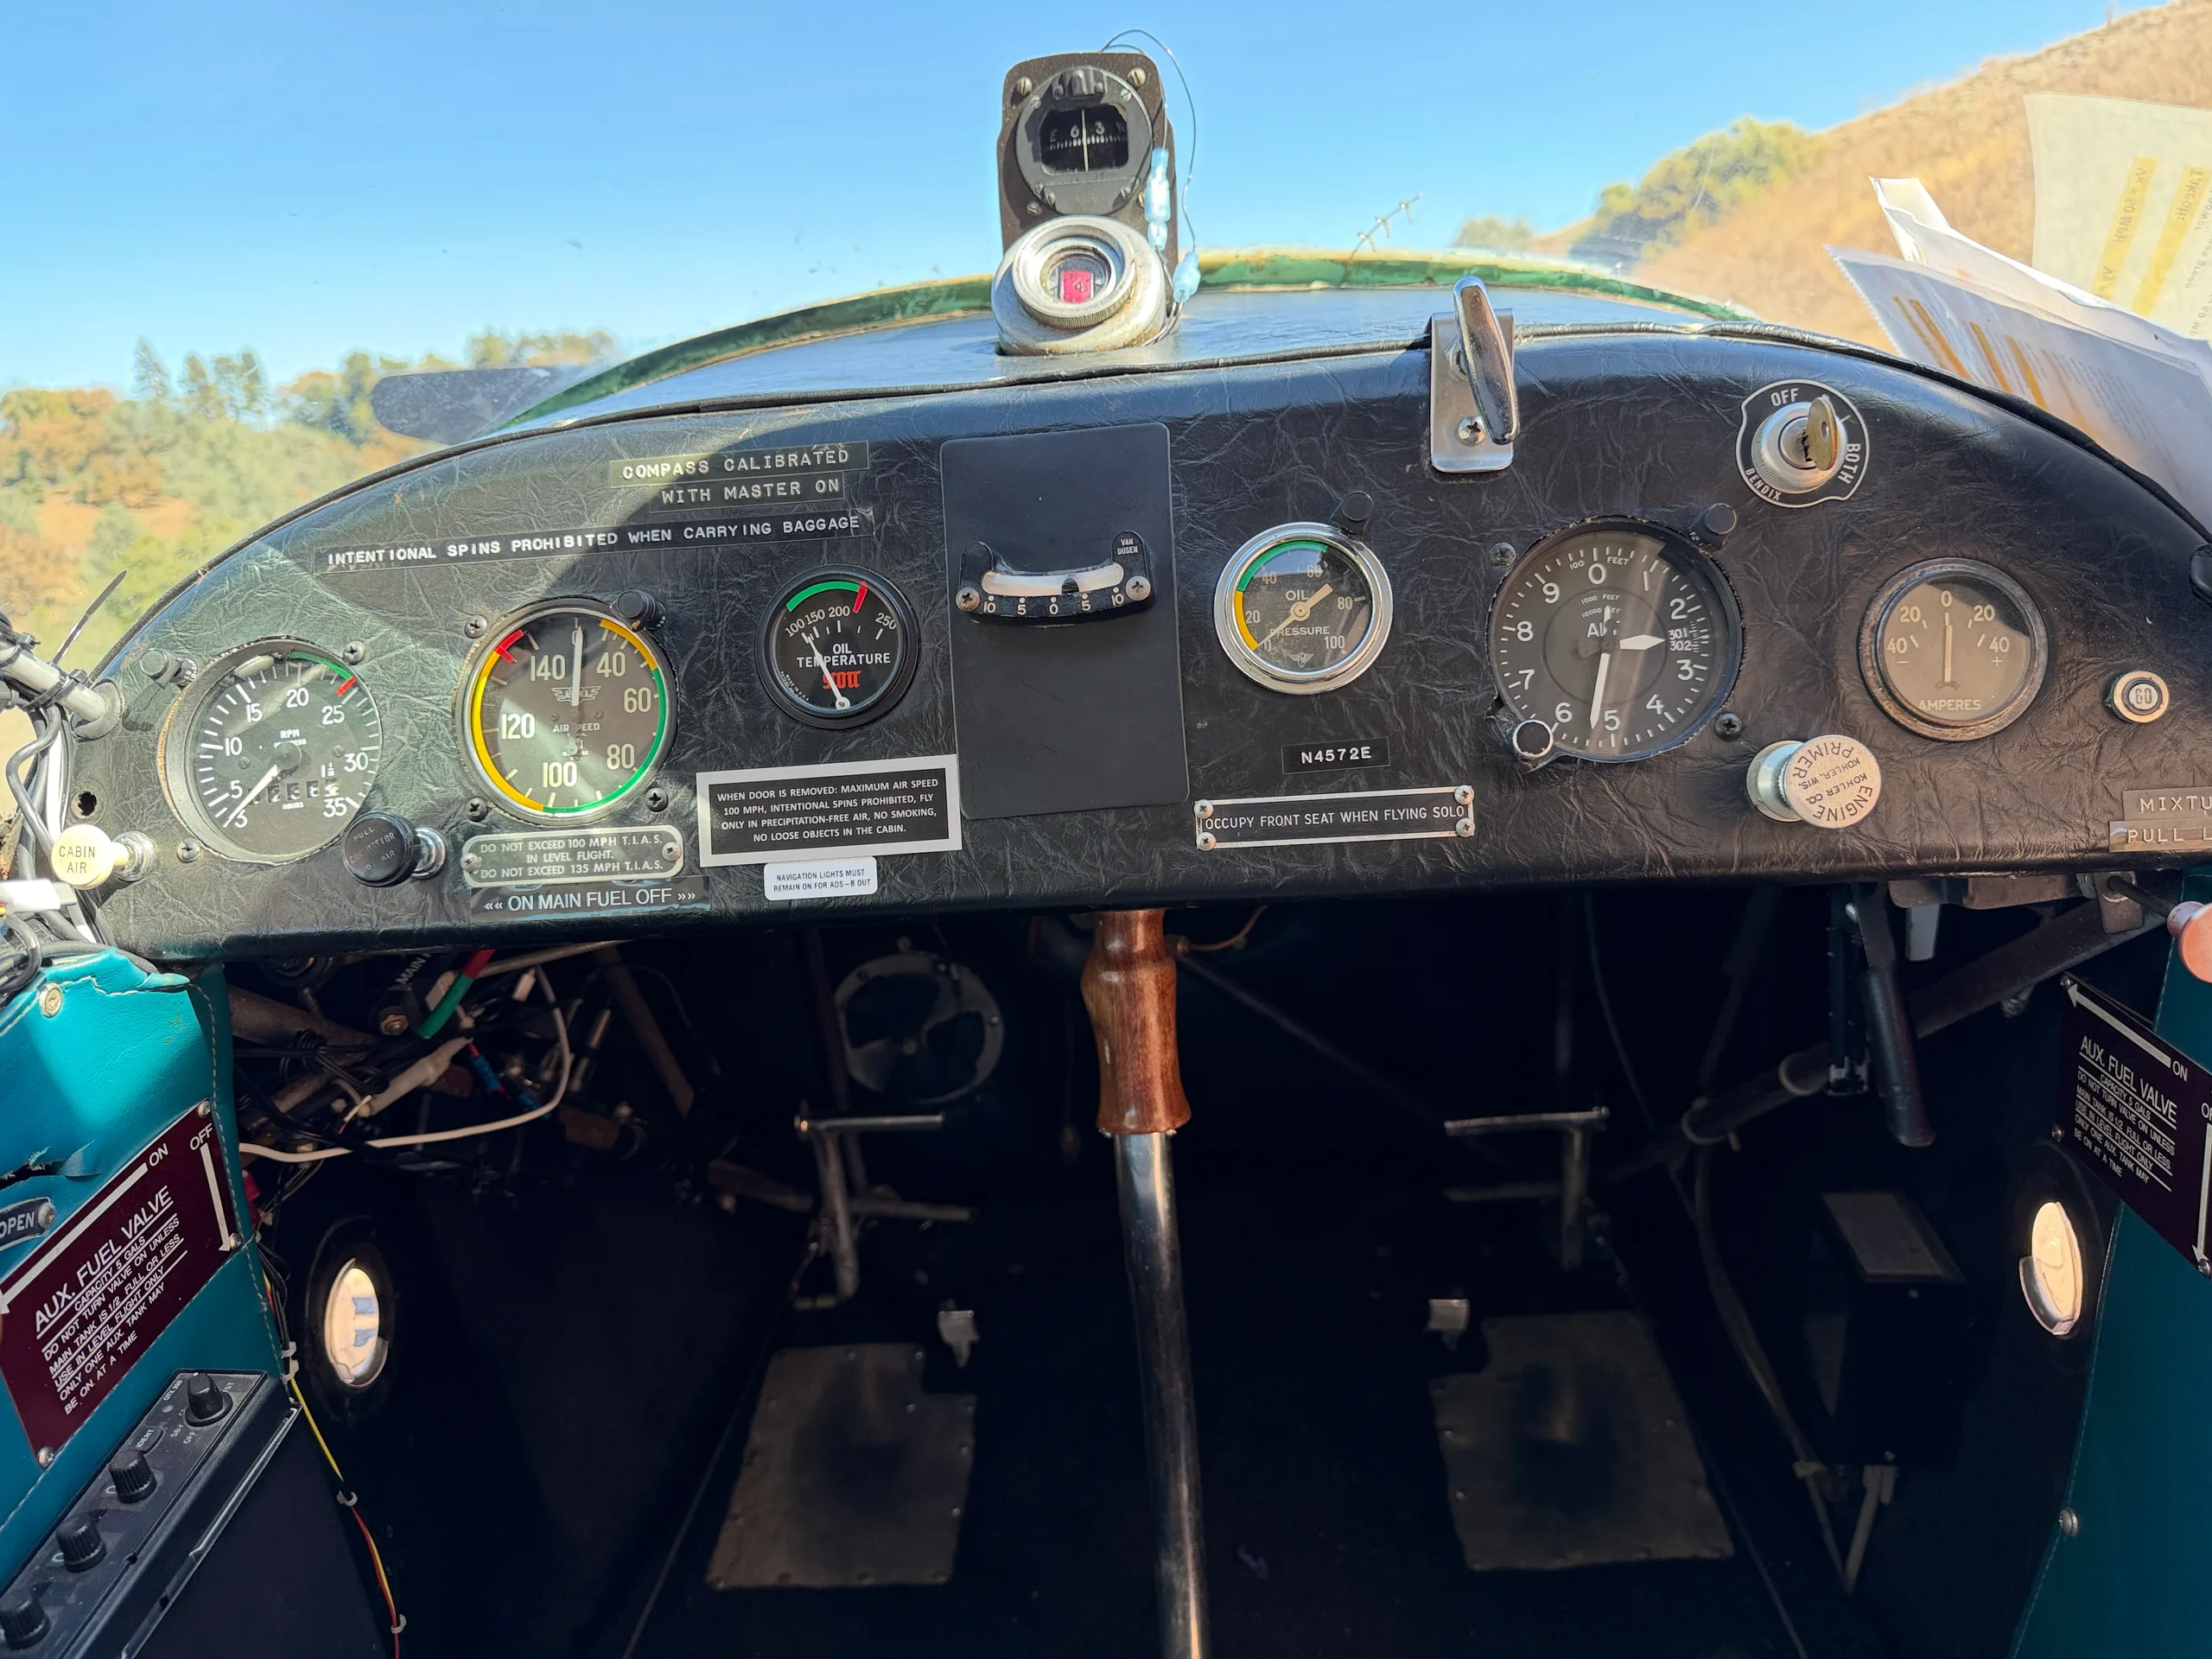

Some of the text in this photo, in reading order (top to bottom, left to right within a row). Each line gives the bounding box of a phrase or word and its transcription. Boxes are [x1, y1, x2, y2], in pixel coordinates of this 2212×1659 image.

[1070, 121, 1105, 137] 6 3
[1770, 388, 1799, 406] OFF
[622, 448, 849, 480] COMPASS CALIBRATED
[1837, 443, 1861, 484] BOTH
[661, 478, 840, 505] WITH MASTER ON
[1745, 467, 1782, 501] BENDIX
[327, 514, 860, 566] INTENTIONAL SPINS PROHIBITED WHEN CARRYING BAGGAGE
[1117, 545, 1138, 555] DUSEN
[1120, 537, 1134, 546] VAN
[1569, 556, 1630, 570] 100 FEET
[1588, 563, 1607, 585] 0
[982, 594, 1124, 615] 10 5 0 5 10
[1285, 590, 1309, 601] OIL
[1337, 596, 1353, 610] 80
[1580, 595, 1597, 604] 1000
[1245, 609, 1261, 624] 20
[1669, 598, 1687, 620] 2
[1899, 590, 1994, 623] 20 0 20
[785, 606, 897, 638] 100 150 200 250
[832, 643, 852, 655] OIL
[1324, 635, 1345, 650] 100
[1886, 636, 2010, 654] 40 40
[531, 652, 626, 681] 140 40
[1676, 659, 1694, 681] 3
[286, 688, 309, 708] 20
[624, 687, 652, 714] 60
[1646, 694, 1664, 715] 4
[1918, 698, 1981, 712] AMPERES
[246, 703, 263, 722] 15
[321, 705, 345, 724] 25
[1604, 710, 1620, 731] 5
[500, 713, 536, 740] 120
[553, 724, 570, 733] AIR
[225, 737, 243, 756] 10
[607, 743, 635, 770] 80
[1300, 746, 1372, 765] N4572E
[345, 752, 368, 772] 30
[1792, 741, 1854, 779] PRIMER
[542, 761, 577, 788] 100
[231, 780, 243, 799] 5
[717, 779, 938, 802] WHEN DOOR IS REMOVED: MAXIMUM AIR SPEED
[1805, 772, 1868, 804] KOHLER CO.
[323, 798, 347, 817] 35
[723, 793, 934, 816] 100 MPH, INTENTIONAL SPINS PROHIBITED, FLY
[1812, 785, 1873, 822] ENGINE
[721, 807, 938, 830] ONLY IN PRECIPITATION-FREE AIR, NO SMOKING,
[1205, 805, 1465, 830] OCCUPY FRONT SEAT WHEN FLYING SOLO
[753, 824, 906, 843] NO LOOSE OBJECTS IN THE CABIN.
[2126, 828, 2183, 843] PULL
[59, 846, 95, 858] CABIN
[480, 843, 497, 854] DO
[501, 842, 524, 853] NOT
[528, 840, 565, 851] EXCEED
[568, 839, 585, 849] 100
[588, 837, 617, 848] MPH
[526, 849, 614, 864] IN LEVEL FLIGHT.
[67, 861, 87, 874] AIR
[480, 868, 497, 880] DO
[501, 867, 524, 878] NOT
[527, 865, 565, 876] EXCEED
[570, 864, 589, 874] 135
[594, 861, 620, 873] MPH
[776, 868, 865, 882] NAVIGATION LIGHTS MUST
[773, 883, 801, 893] REMAIN
[802, 882, 813, 891] ON
[814, 881, 829, 890] FOR
[857, 878, 871, 887] OUT
[508, 887, 672, 912] ON MAIN FUEL OFF
[2080, 1035, 2177, 1122] AUX. FUEL VALVE
[189, 1123, 213, 1152] OFF
[148, 1143, 169, 1167] ON
[0, 1211, 35, 1239] OPEN
[35, 1185, 171, 1332] AUX. FUEL VALVE
[74, 1236, 145, 1311] CAPACITY 5 GALS
[135, 1429, 155, 1448] IDENT
